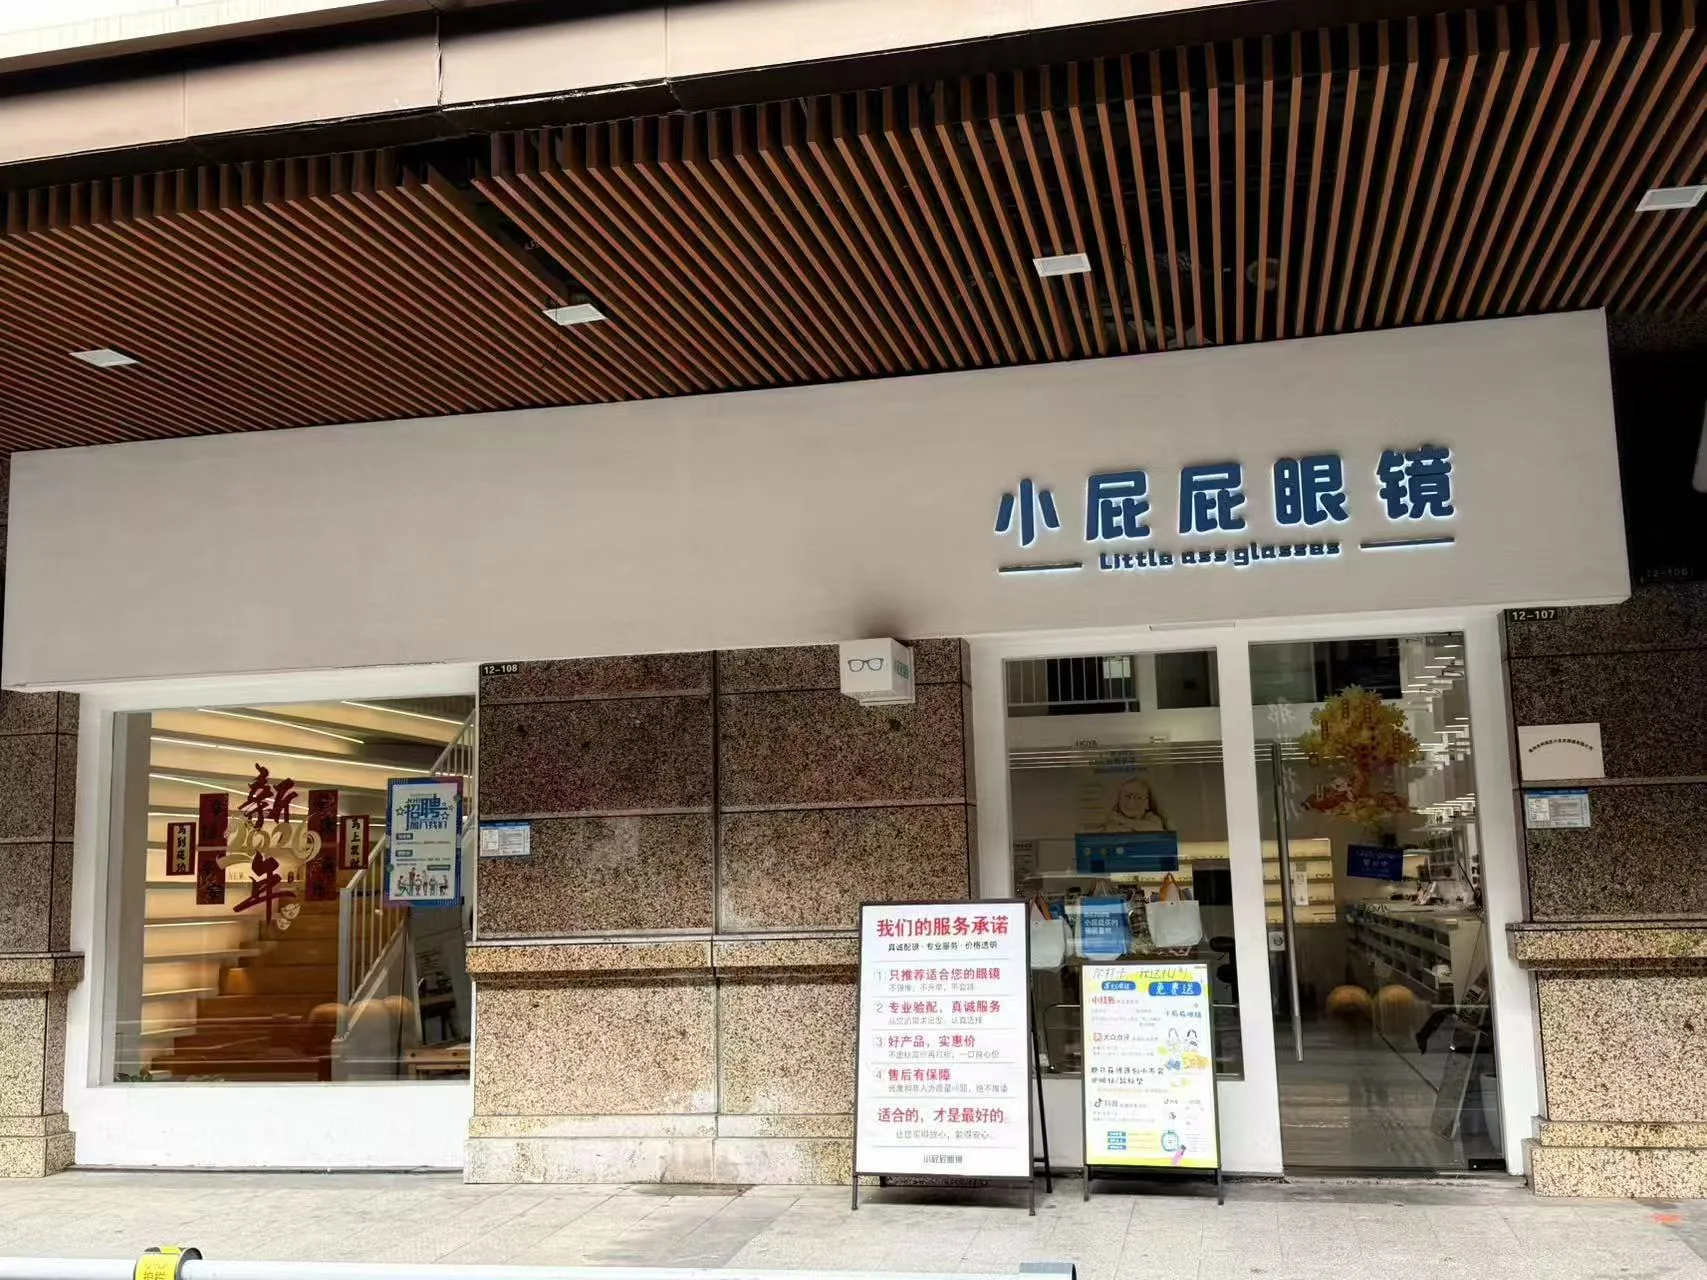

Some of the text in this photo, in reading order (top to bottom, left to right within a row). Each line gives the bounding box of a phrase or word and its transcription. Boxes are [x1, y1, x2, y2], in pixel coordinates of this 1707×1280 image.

[994, 443, 1456, 547] 小屁屁眼镜
[1100, 539, 1341, 571] Little ass glasses
[1512, 610, 1556, 621] 12-107
[484, 664, 518, 674] 12-108
[216, 814, 322, 868] 2026
[233, 850, 297, 926] 年
[877, 915, 1009, 937] 我们的服务承诺
[889, 967, 1001, 982] 只推荐适合您的眼镜
[888, 1000, 1001, 1014] 专业验配，真诚服务
[888, 1035, 976, 1049] 好产品，实惠价
[888, 1068, 952, 1082] 售后有保障
